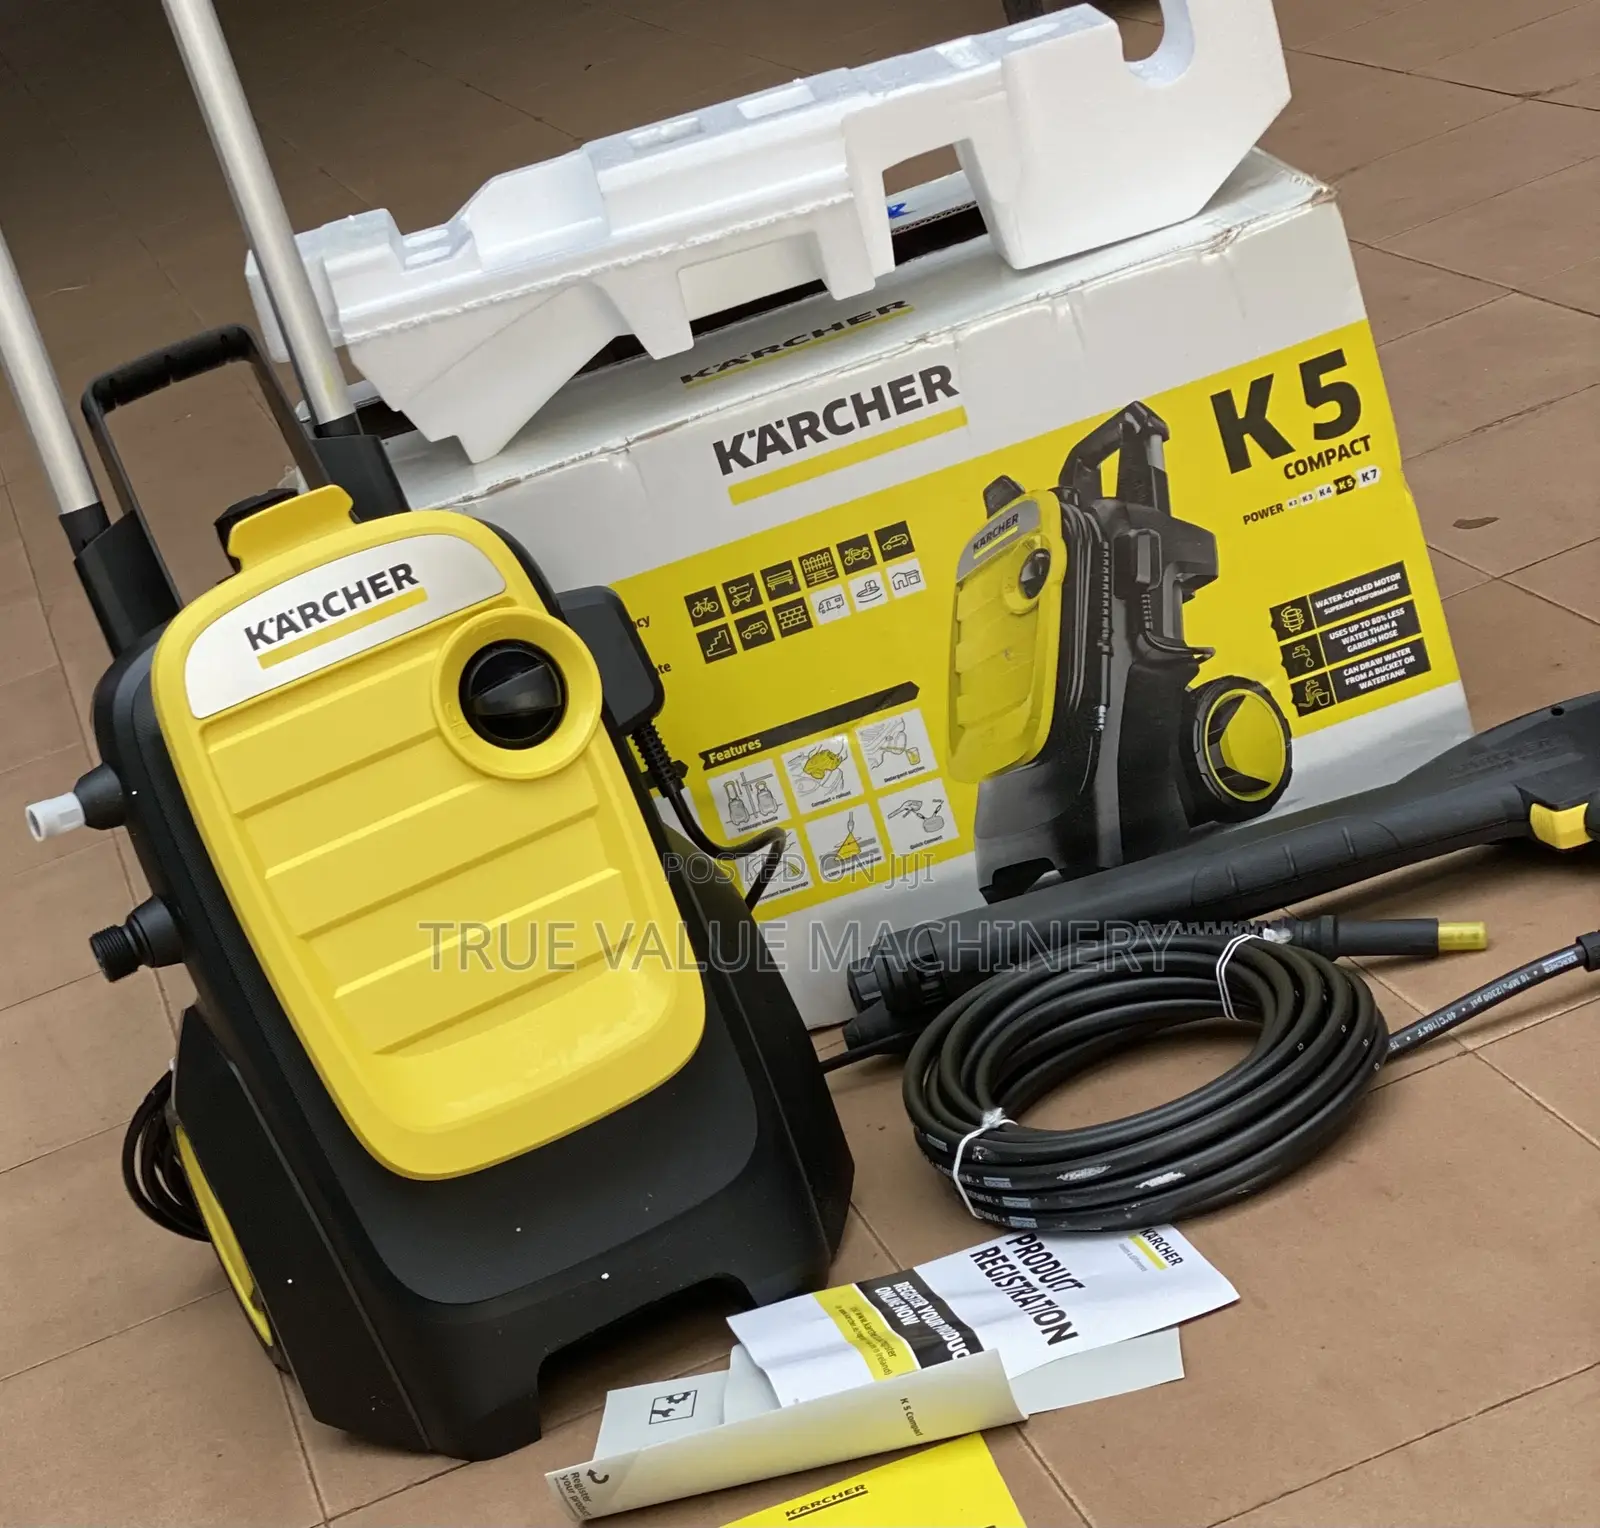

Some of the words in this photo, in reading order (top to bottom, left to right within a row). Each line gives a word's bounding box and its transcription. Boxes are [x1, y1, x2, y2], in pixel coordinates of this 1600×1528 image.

[680, 300, 912, 384] KÄRCHER
[712, 364, 959, 476] KÄRCHER
[1210, 372, 1296, 474] K
[1299, 348, 1361, 441] 5
[1284, 434, 1370, 480] COMPACT
[1242, 502, 1284, 525] POWER
[1374, 572, 1401, 587] MOTOR
[244, 563, 420, 651] KÄRCHER
[1329, 627, 1348, 640] USES
[1349, 624, 1359, 633] UP
[1360, 621, 1370, 629] TO
[1388, 607, 1405, 620] LESS
[1342, 630, 1368, 645] WATER
[1369, 623, 1390, 636] THAN
[1348, 638, 1377, 652] GARDEN
[1378, 630, 1398, 642] HOSE
[1344, 666, 1359, 676] CAN
[1360, 657, 1383, 671] DRAW
[1384, 647, 1411, 662] WATER
[1345, 671, 1368, 686] FROM
[1368, 669, 1374, 677] A
[1375, 660, 1403, 674] BUCKET
[1404, 656, 1415, 664] OR
[1359, 668, 1406, 690] WATERTANK
[708, 738, 762, 764] Features
[1006, 1233, 1085, 1291] PRODUCT
[874, 1286, 904, 1314] ONLINE
[896, 1307, 920, 1326] NOW
[893, 1281, 928, 1307] REGISTER
[918, 1305, 944, 1329] YOUR
[969, 1246, 1080, 1346] REGISTRATION
[560, 1475, 575, 1494] your
[571, 1472, 592, 1502] Register
